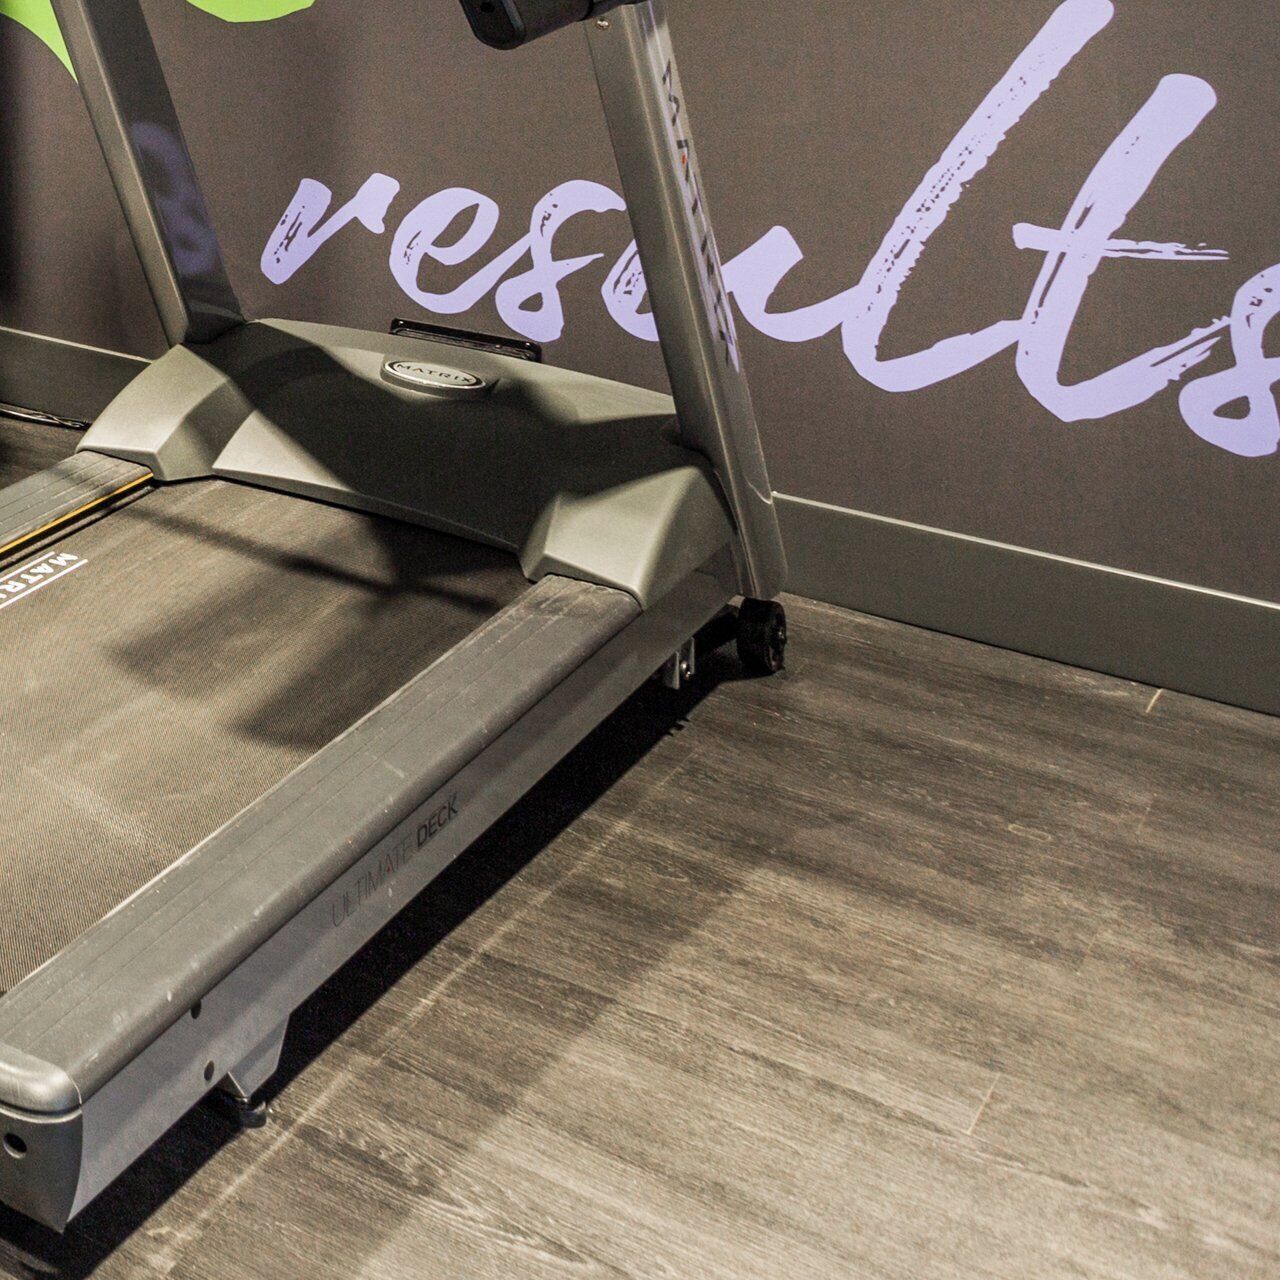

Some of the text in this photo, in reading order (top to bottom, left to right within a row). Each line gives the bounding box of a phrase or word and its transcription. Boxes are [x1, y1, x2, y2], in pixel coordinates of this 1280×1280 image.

[396, 363, 474, 383] MATRIX
[331, 791, 459, 928] ULTIMATE DECK
